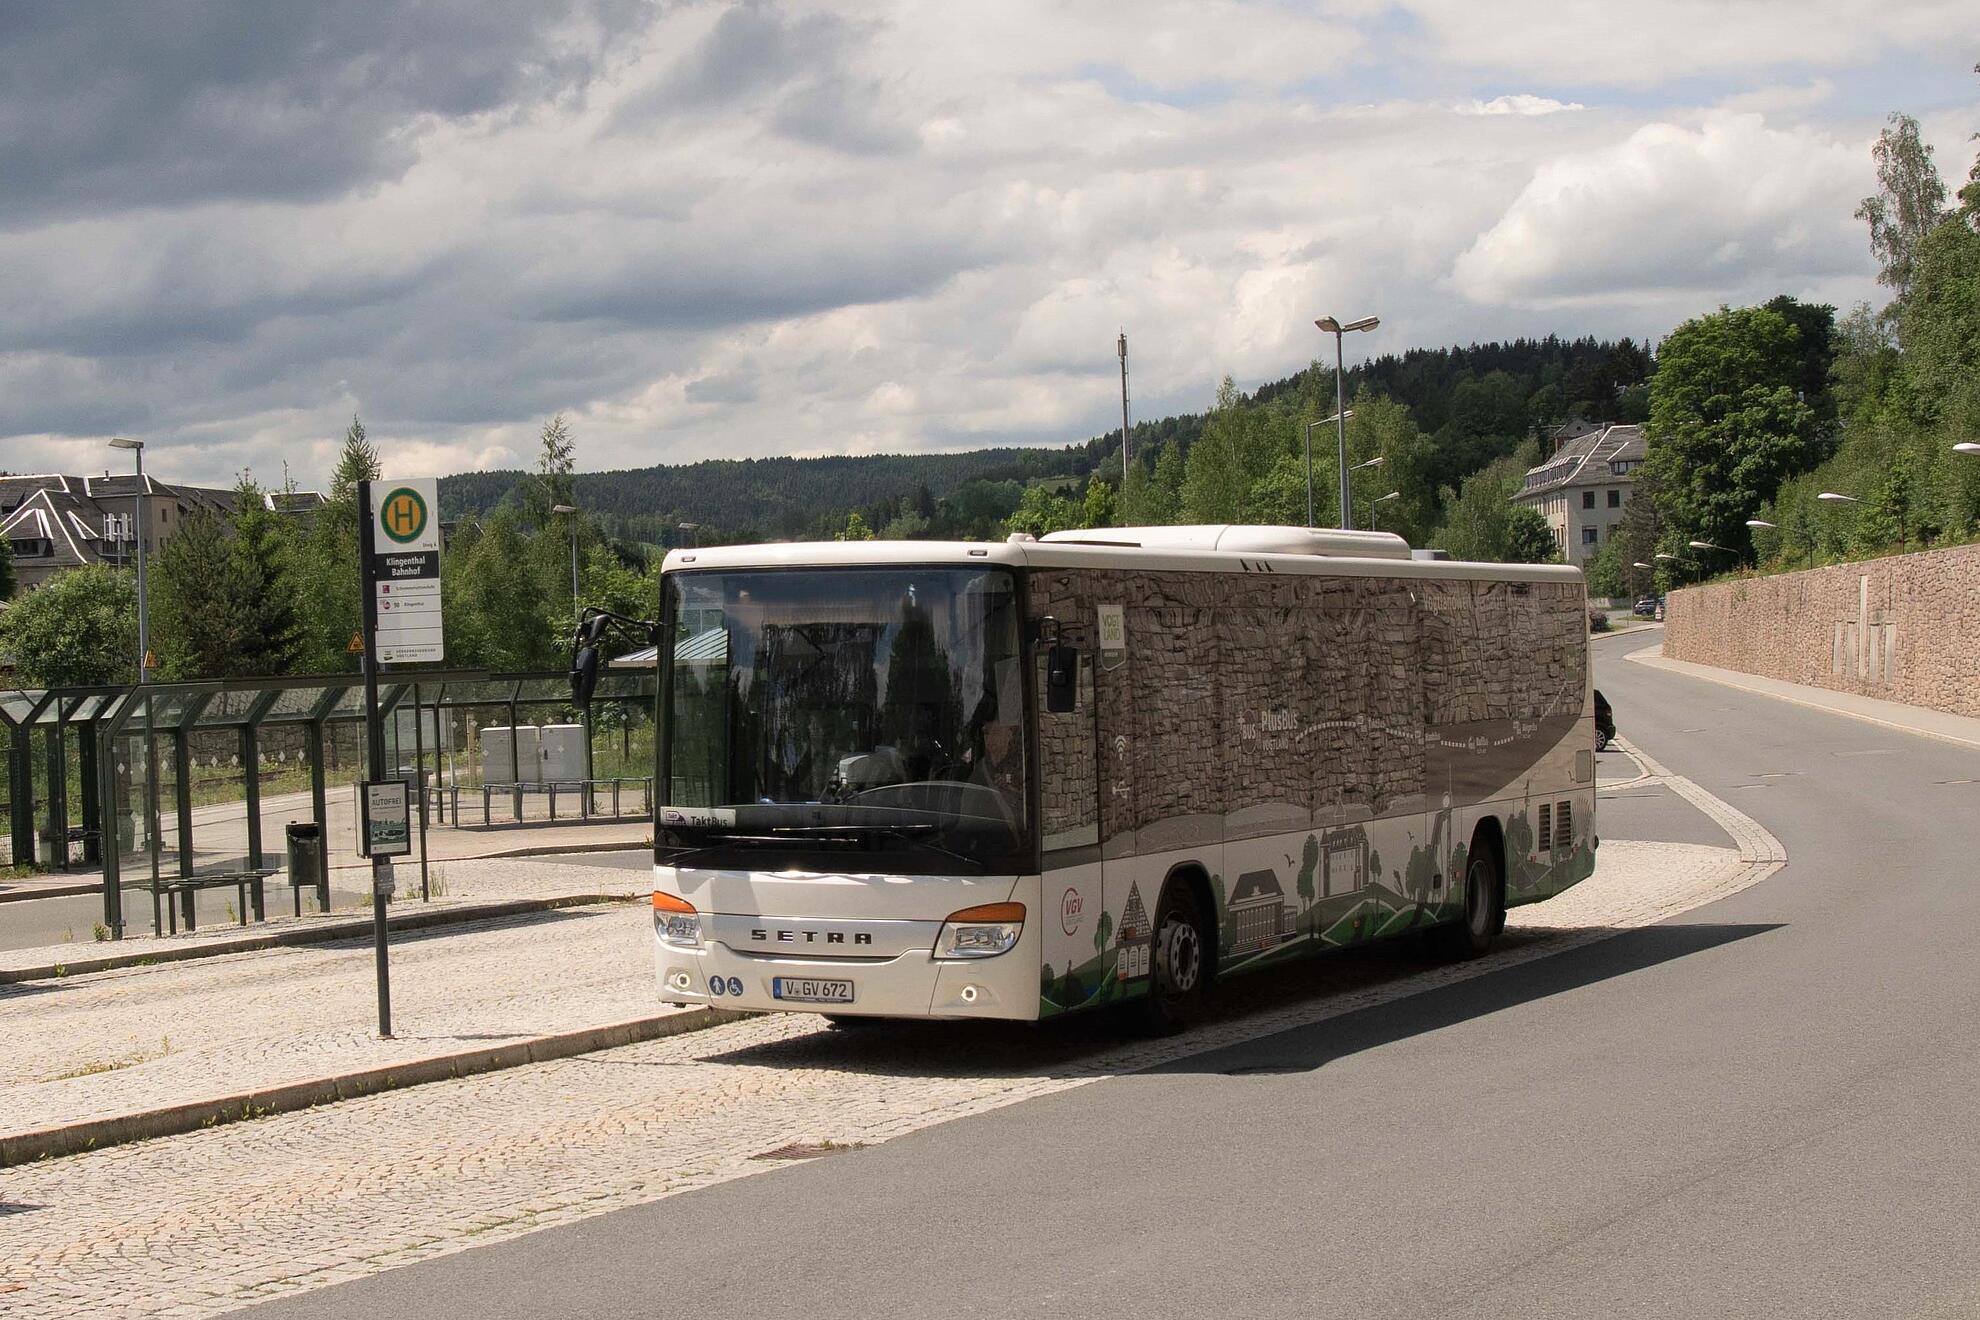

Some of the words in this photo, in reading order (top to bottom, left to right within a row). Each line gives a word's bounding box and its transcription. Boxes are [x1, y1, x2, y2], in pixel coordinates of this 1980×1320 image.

[394, 500, 413, 531] H
[386, 556, 425, 567] Klingenthal
[391, 566, 421, 576] Bahnhof
[1261, 709, 1298, 731] PlusBus
[371, 798, 402, 806] AUTOFREI
[691, 816, 728, 827] TaktBus
[1065, 898, 1084, 915] VGV
[751, 929, 872, 944] SETRA
[786, 981, 794, 995] V
[802, 982, 819, 997] GV
[822, 983, 847, 998] 672
